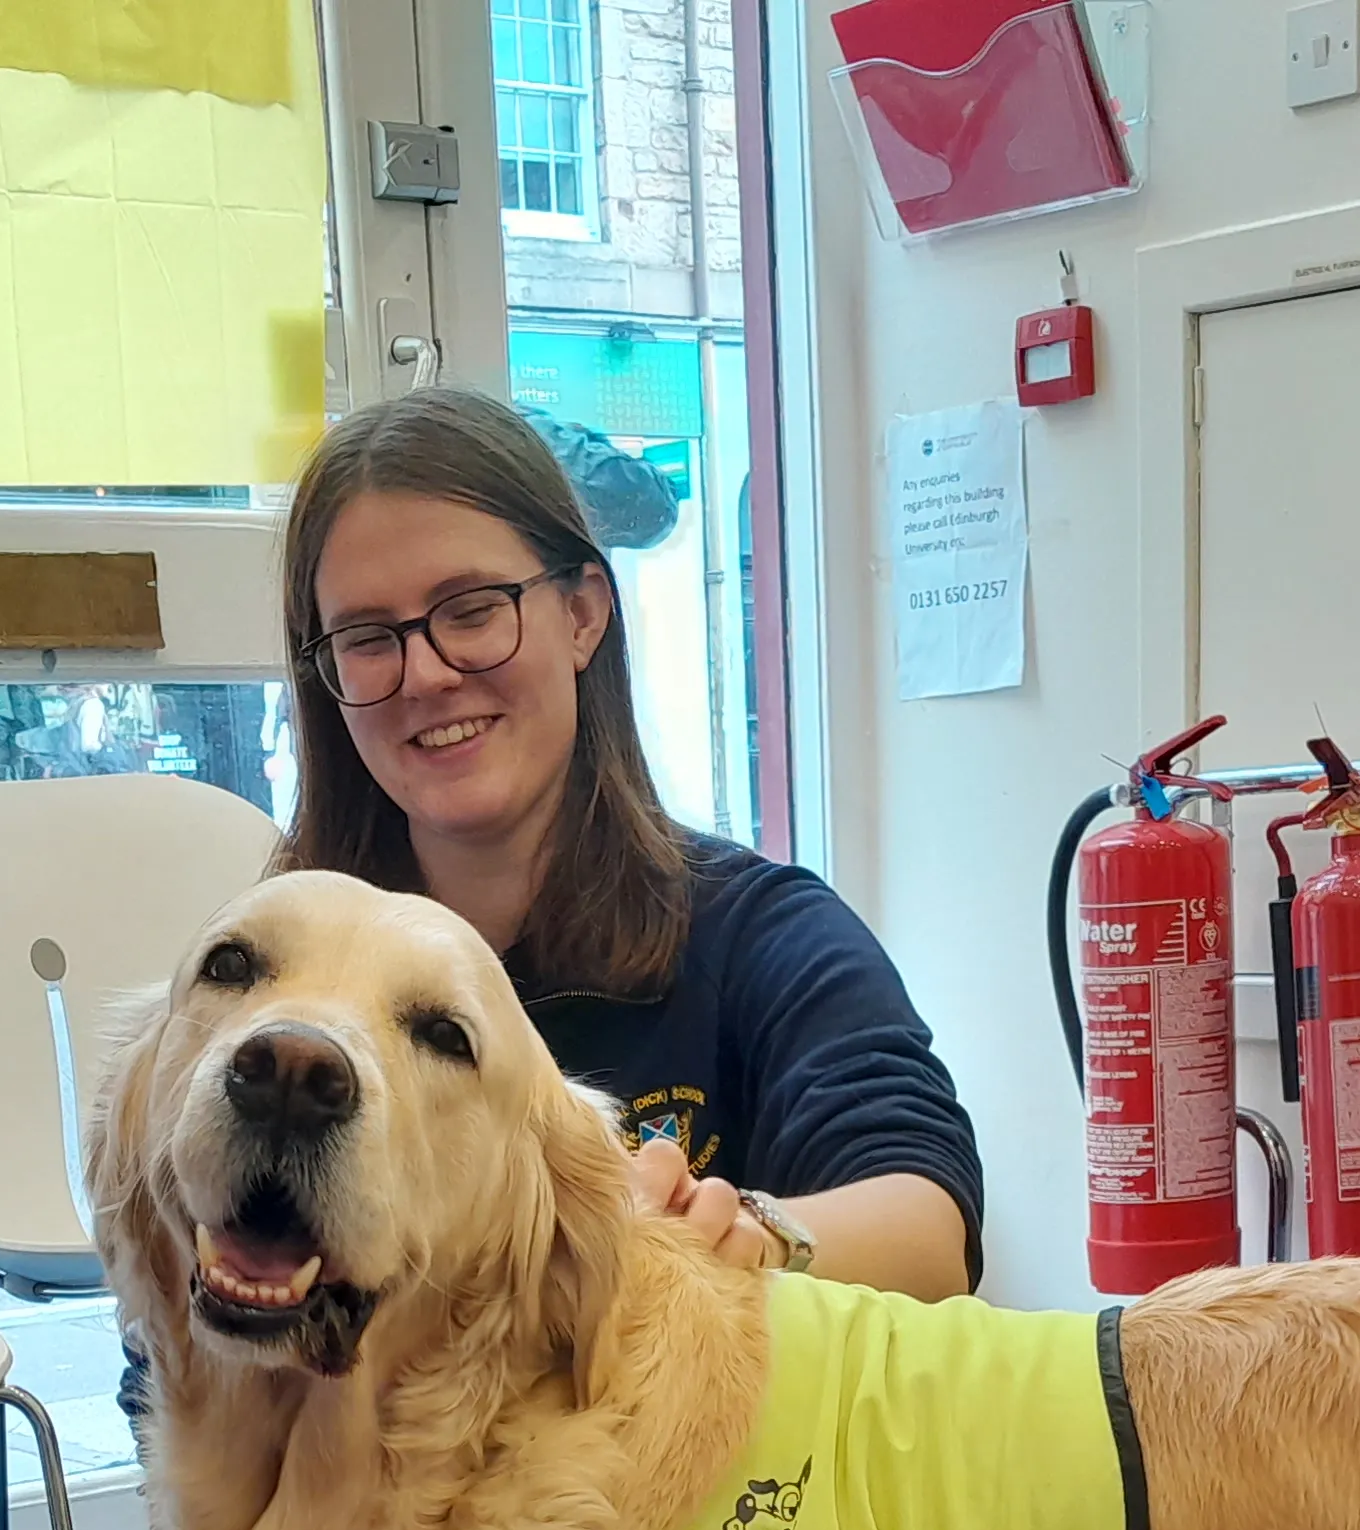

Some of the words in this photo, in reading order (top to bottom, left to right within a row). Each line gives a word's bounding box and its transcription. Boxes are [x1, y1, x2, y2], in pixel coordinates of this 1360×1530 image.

[903, 479, 918, 492] Any
[903, 496, 943, 515] regarding
[944, 491, 962, 505] this
[963, 487, 1005, 501] building
[904, 519, 931, 536] please
[932, 514, 948, 530] call
[950, 508, 1000, 526] Edinburgh
[904, 539, 948, 556] University
[910, 589, 942, 610] 0131
[944, 585, 969, 605] 650
[973, 580, 1008, 600] 2257
[1099, 942, 1137, 956] Spray
[632, 1088, 668, 1114] (DICK)
[671, 1085, 706, 1106] SCHOOL
[688, 1133, 721, 1176] TUDIES
